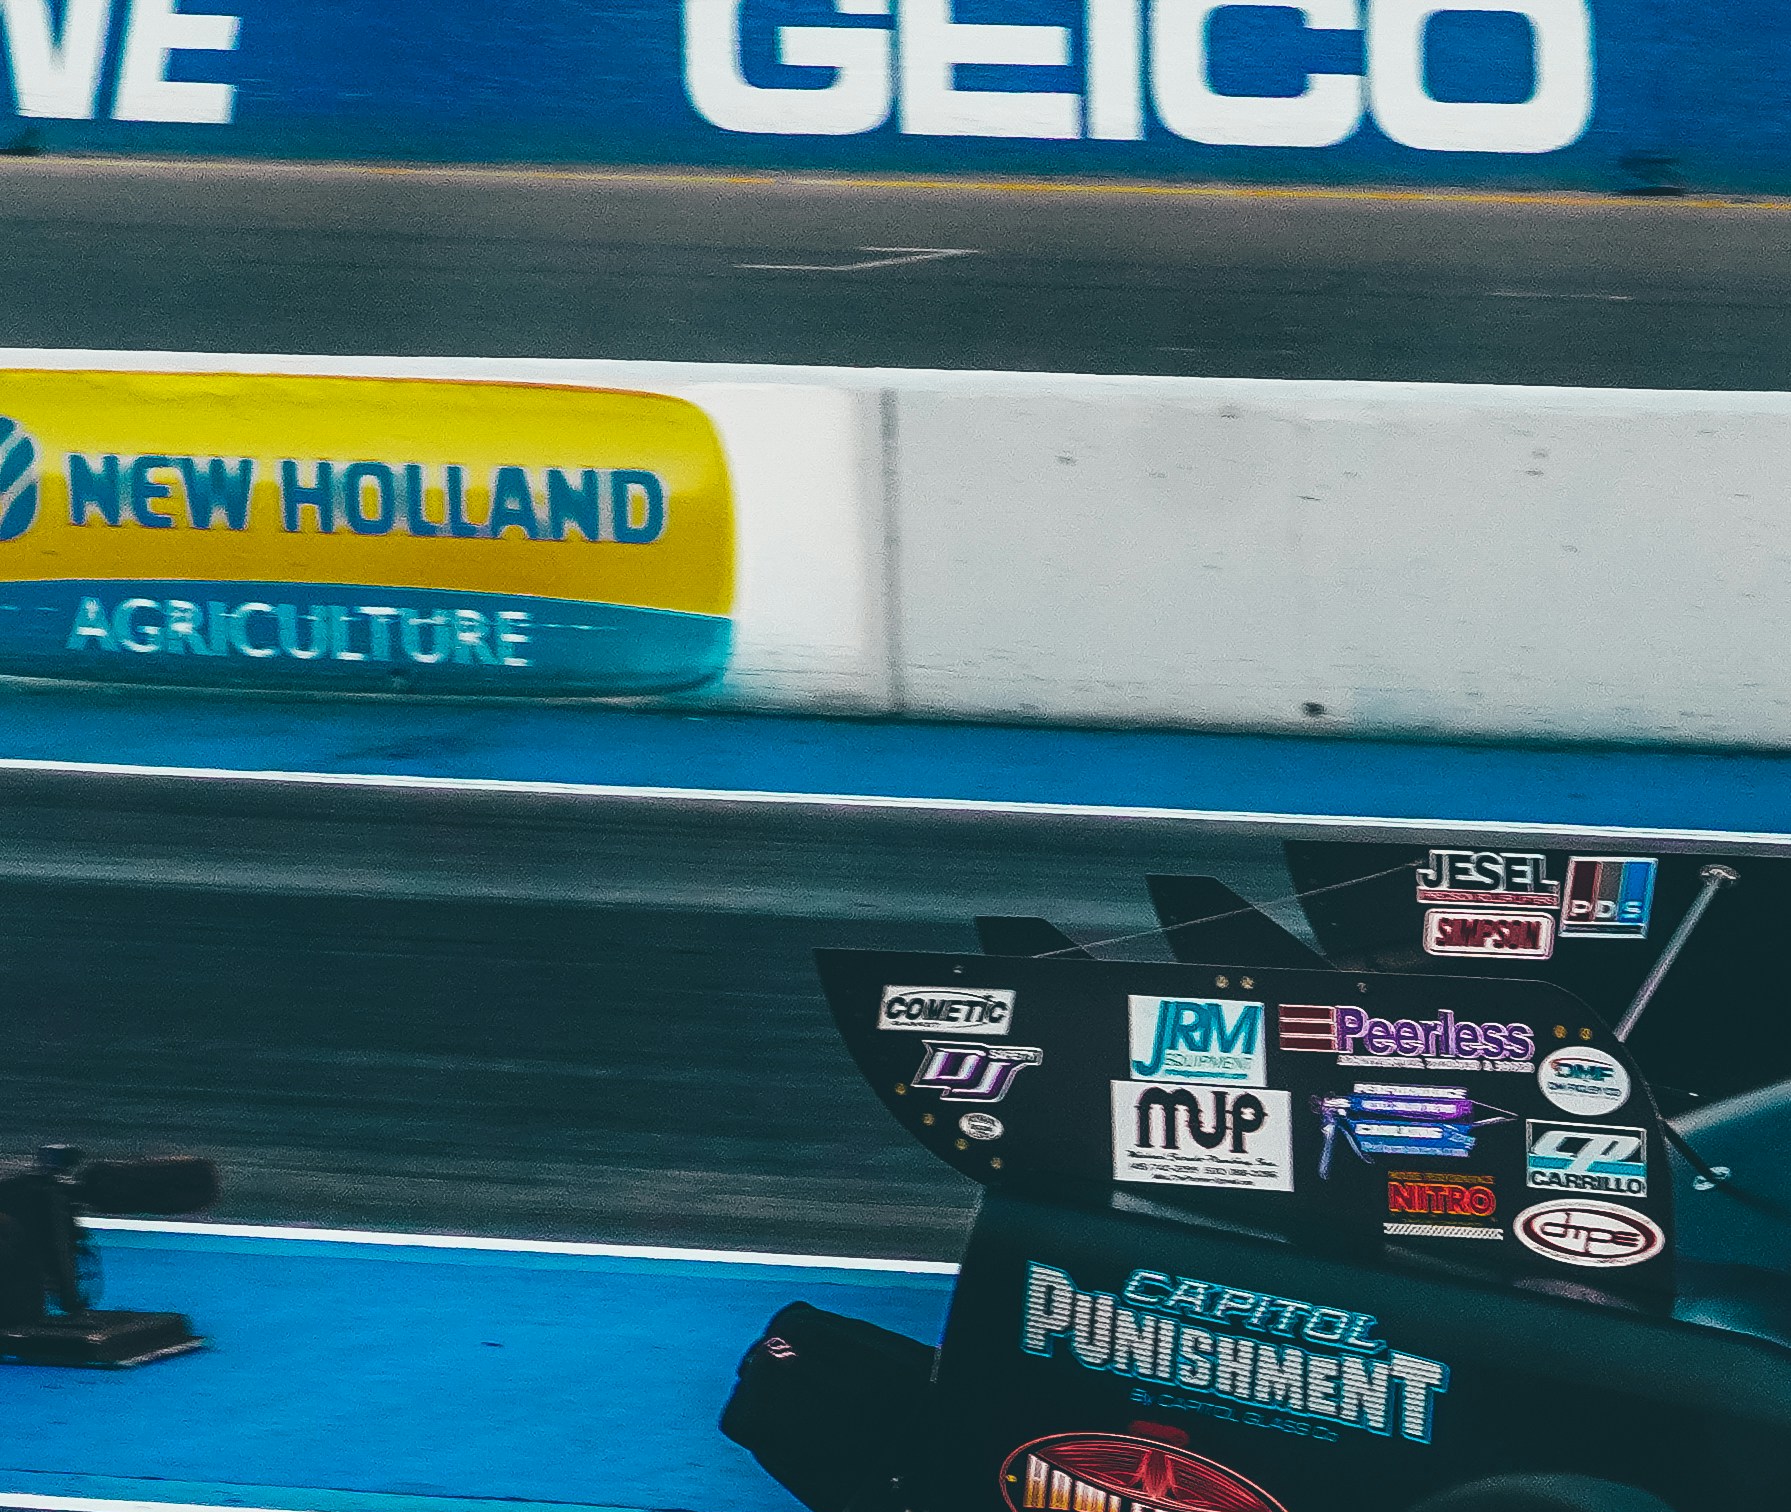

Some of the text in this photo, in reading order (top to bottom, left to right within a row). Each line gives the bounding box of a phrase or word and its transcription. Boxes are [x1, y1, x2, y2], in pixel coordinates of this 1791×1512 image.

[683, 0, 1594, 153] GEICO
[66, 452, 667, 545] NEW HOLLAND
[66, 596, 534, 667] AGRICULTURE
[1416, 849, 1560, 893] JESEL
[1435, 917, 1543, 950] SIMPSON
[1569, 899, 1646, 924] PDS
[886, 996, 1009, 1025] COMETIC
[1131, 1000, 1265, 1077] JRM
[1334, 1004, 1536, 1062] Peerless
[1387, 1181, 1497, 1217] NITRO
[1531, 1171, 1646, 1195] CARRILLO
[1121, 1268, 1387, 1355] CAPITOL
[1020, 1260, 1450, 1444] PUNISHMENT
